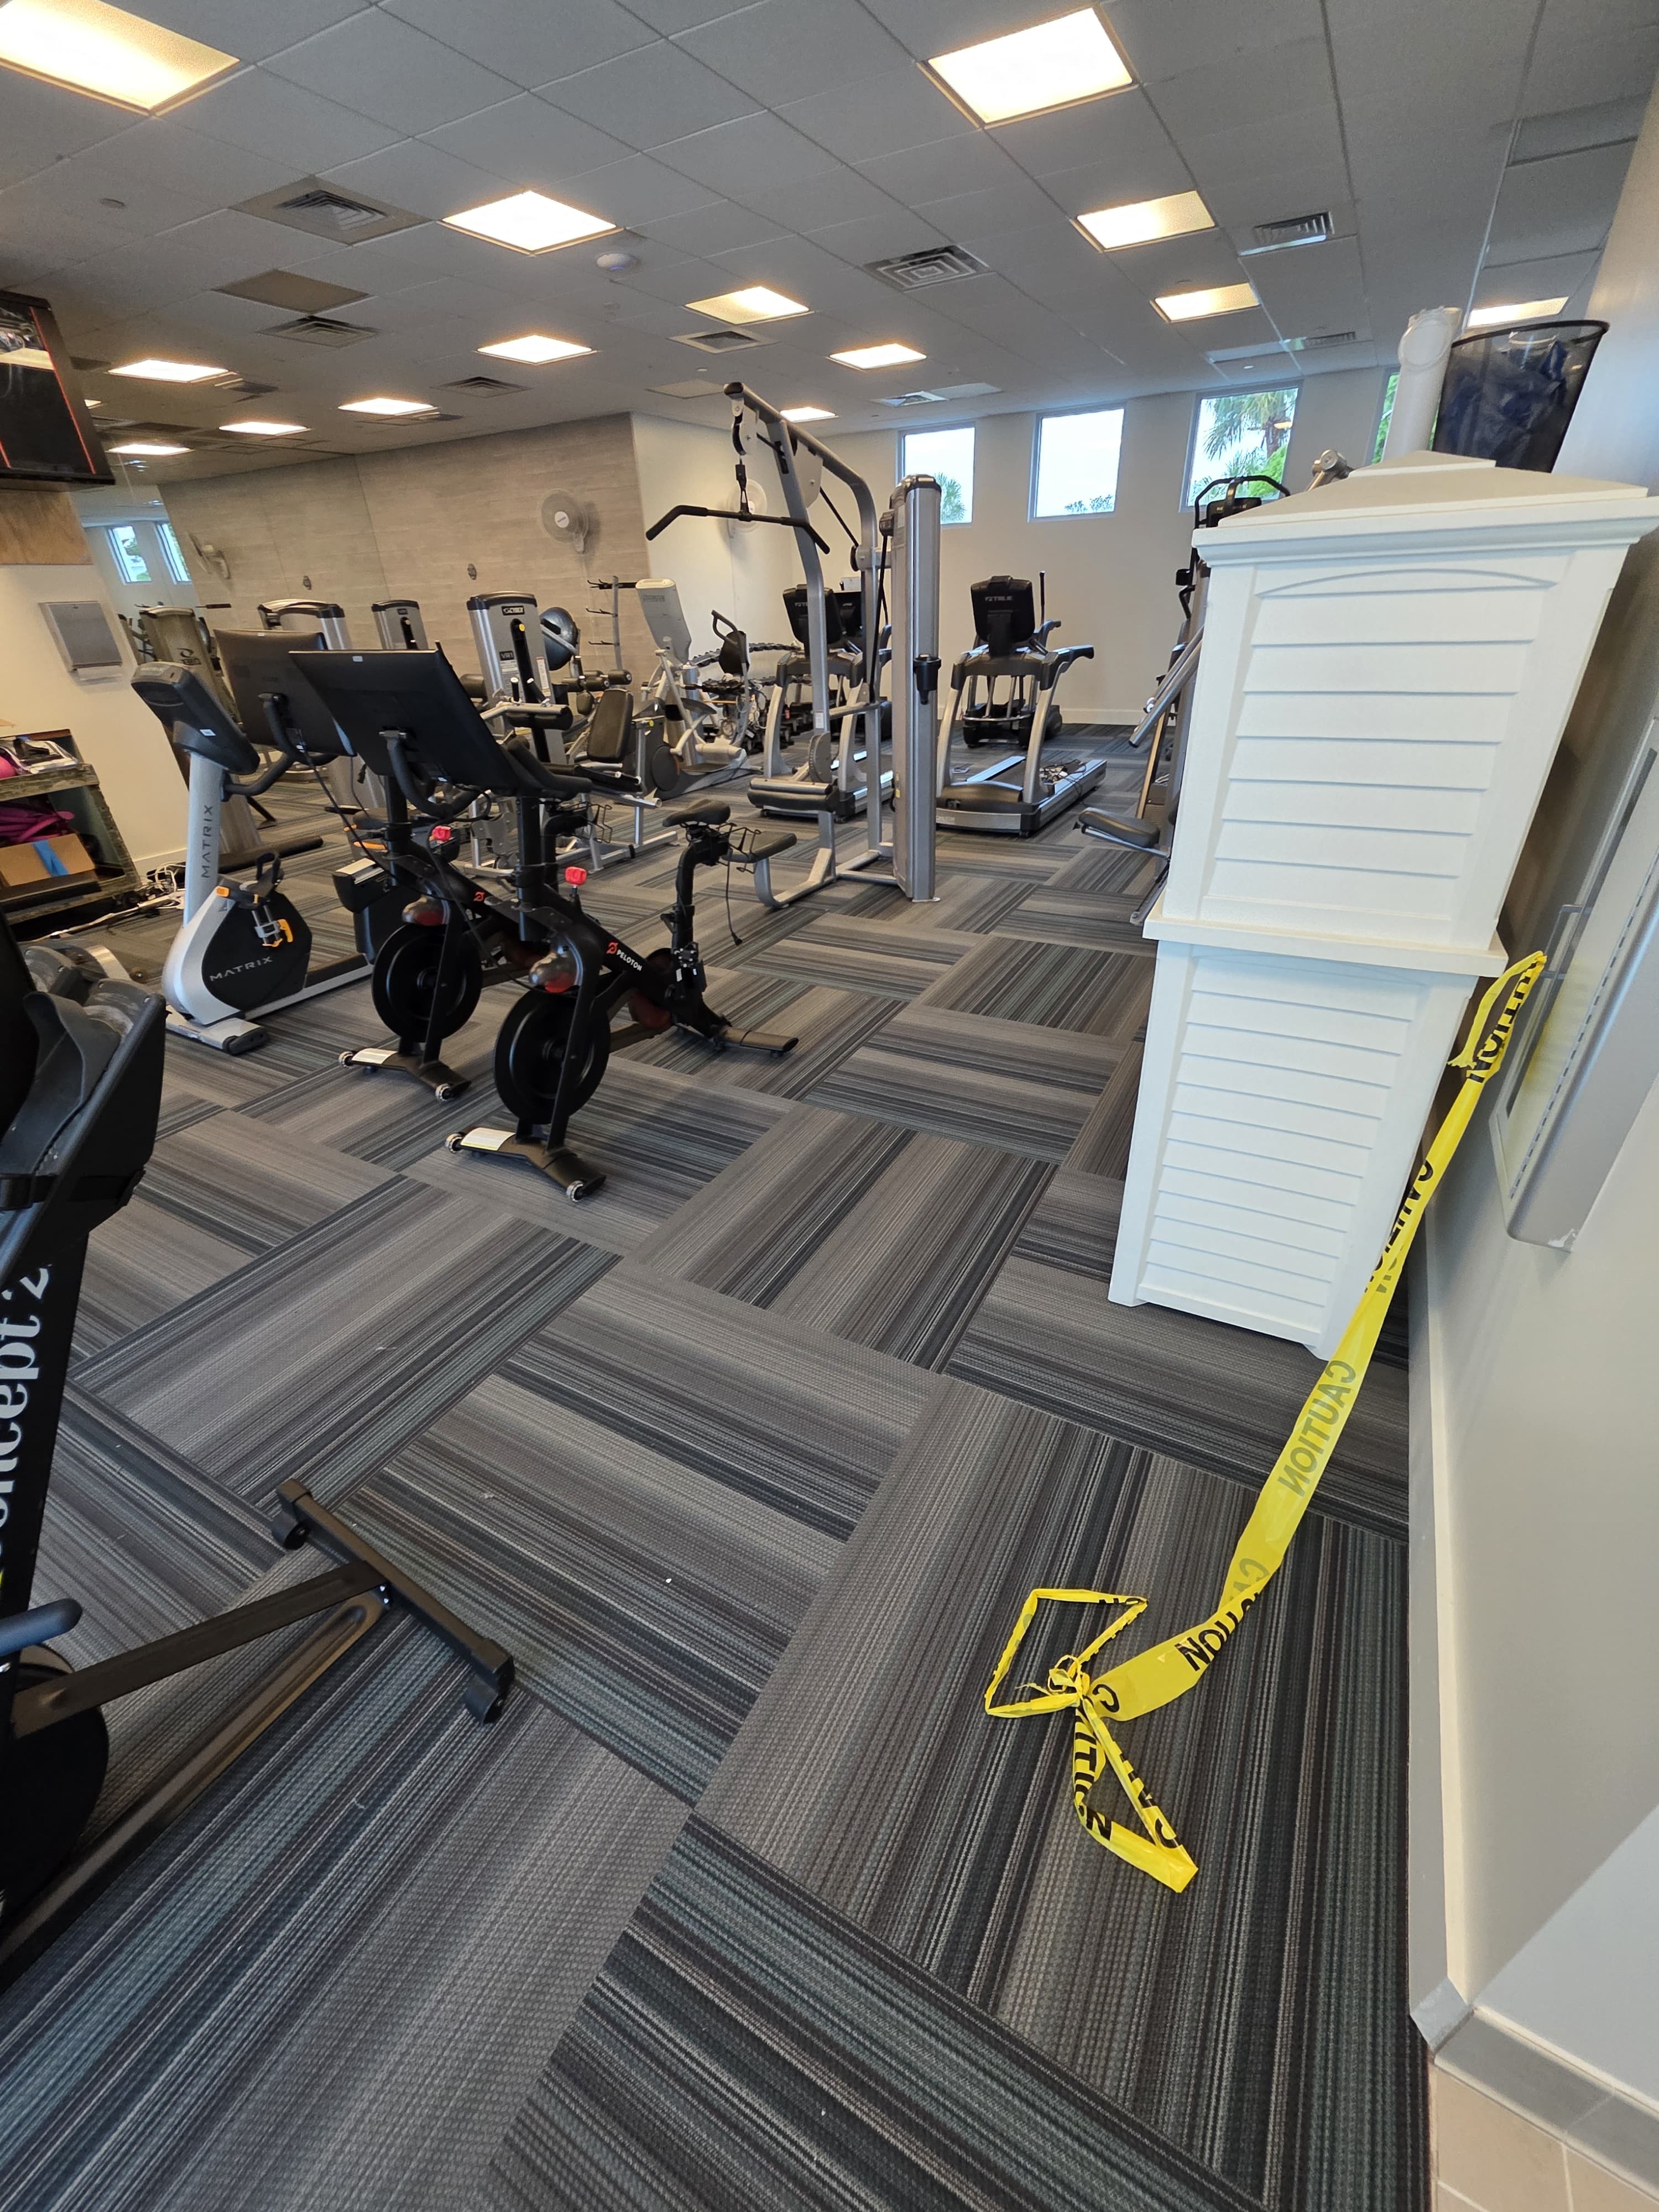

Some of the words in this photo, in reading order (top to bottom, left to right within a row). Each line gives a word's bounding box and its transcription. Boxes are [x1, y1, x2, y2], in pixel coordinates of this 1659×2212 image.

[201, 805, 213, 878] MATRIX
[210, 956, 273, 982] MATRIX
[617, 950, 643, 971] PELOTON
